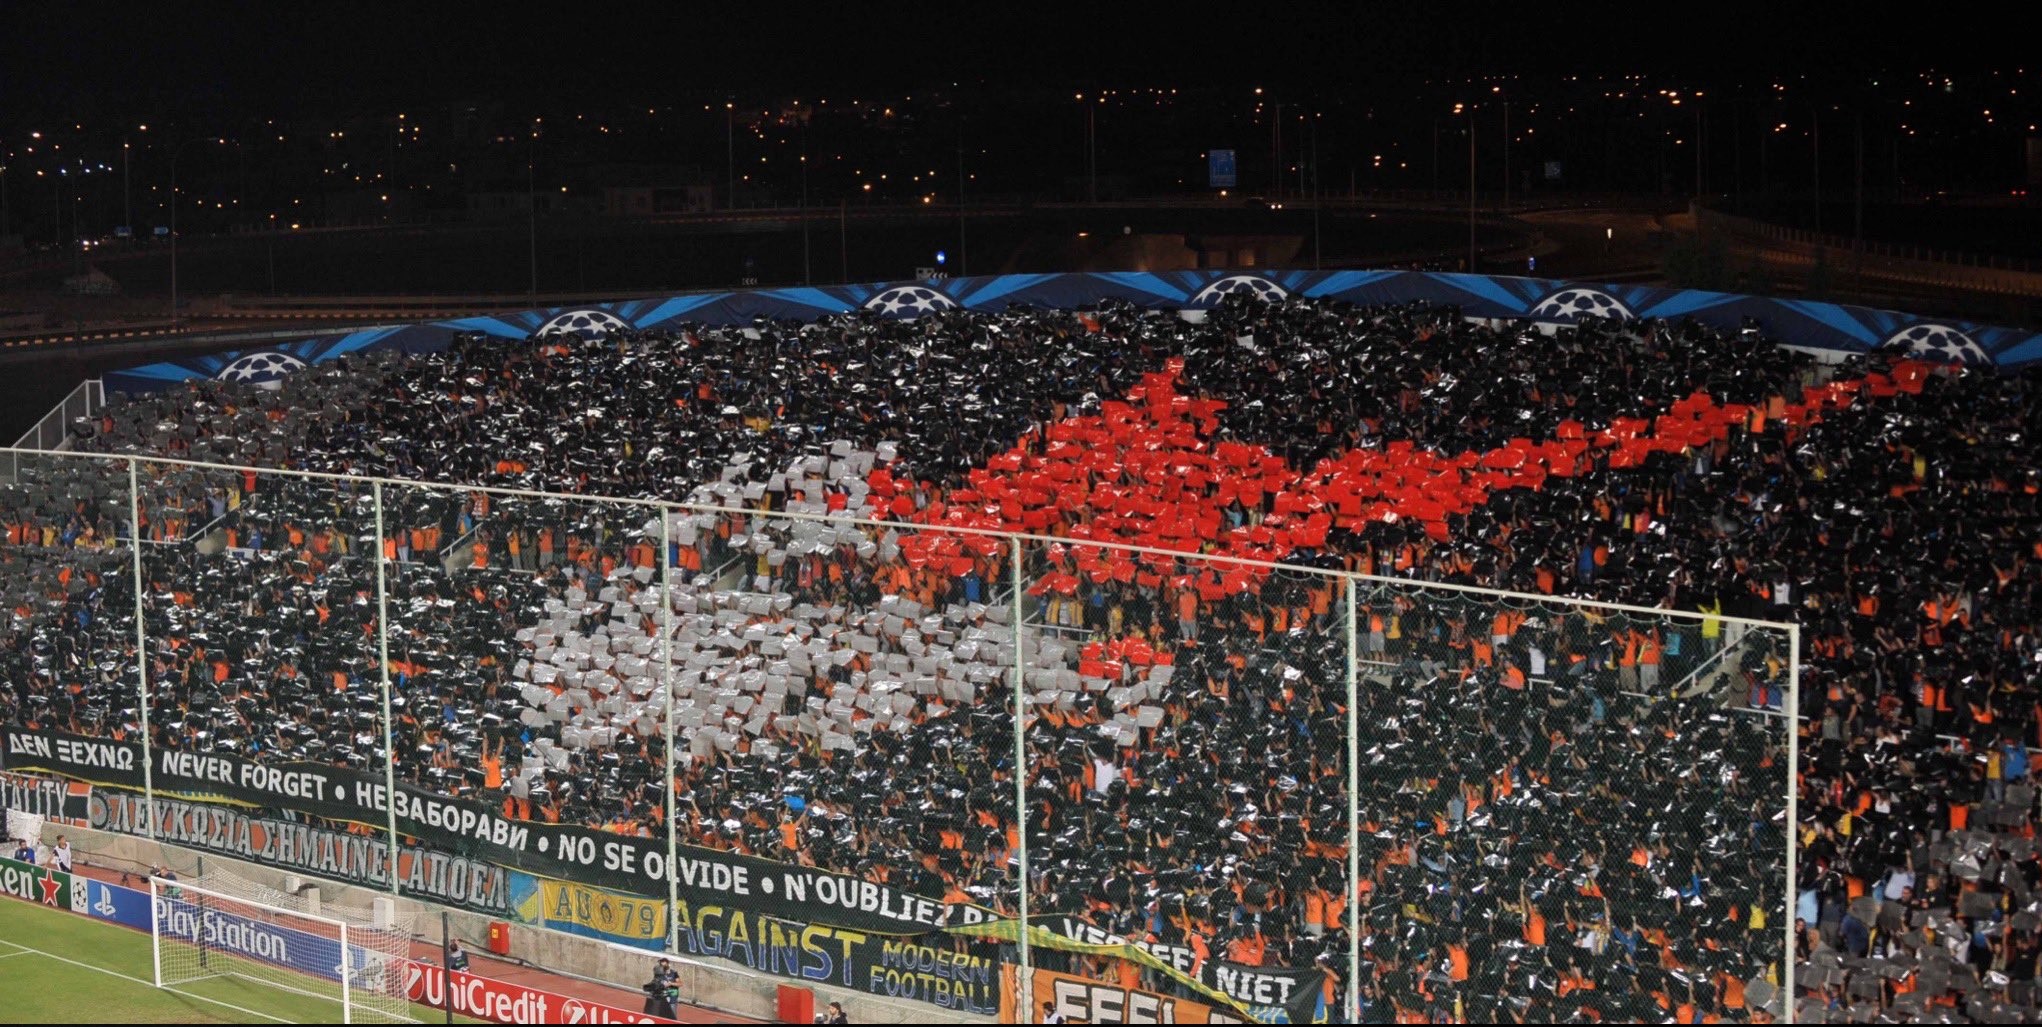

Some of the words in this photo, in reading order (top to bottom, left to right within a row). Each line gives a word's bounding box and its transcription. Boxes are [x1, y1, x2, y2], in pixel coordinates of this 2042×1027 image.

[9, 733, 52, 759] ΔΕΝ
[56, 739, 134, 771] ΞΕΧΝΩ
[162, 751, 235, 785] NEVER
[241, 763, 327, 801] FORGET
[113, 794, 253, 856] ΛΕΥΚΩΣΙΑ
[408, 850, 506, 909] ΑΠΟΕΛ
[558, 834, 596, 865] NO
[604, 842, 635, 873] SE
[157, 899, 287, 962] PlayStation
[555, 886, 592, 922] AU
[620, 902, 656, 936] 79
[667, 899, 867, 987] AGAINST
[882, 939, 991, 985] MODERN
[426, 967, 547, 1024] UniCredit
[870, 964, 996, 1014] FOOTBALL
[1216, 965, 1296, 1004] NIET
